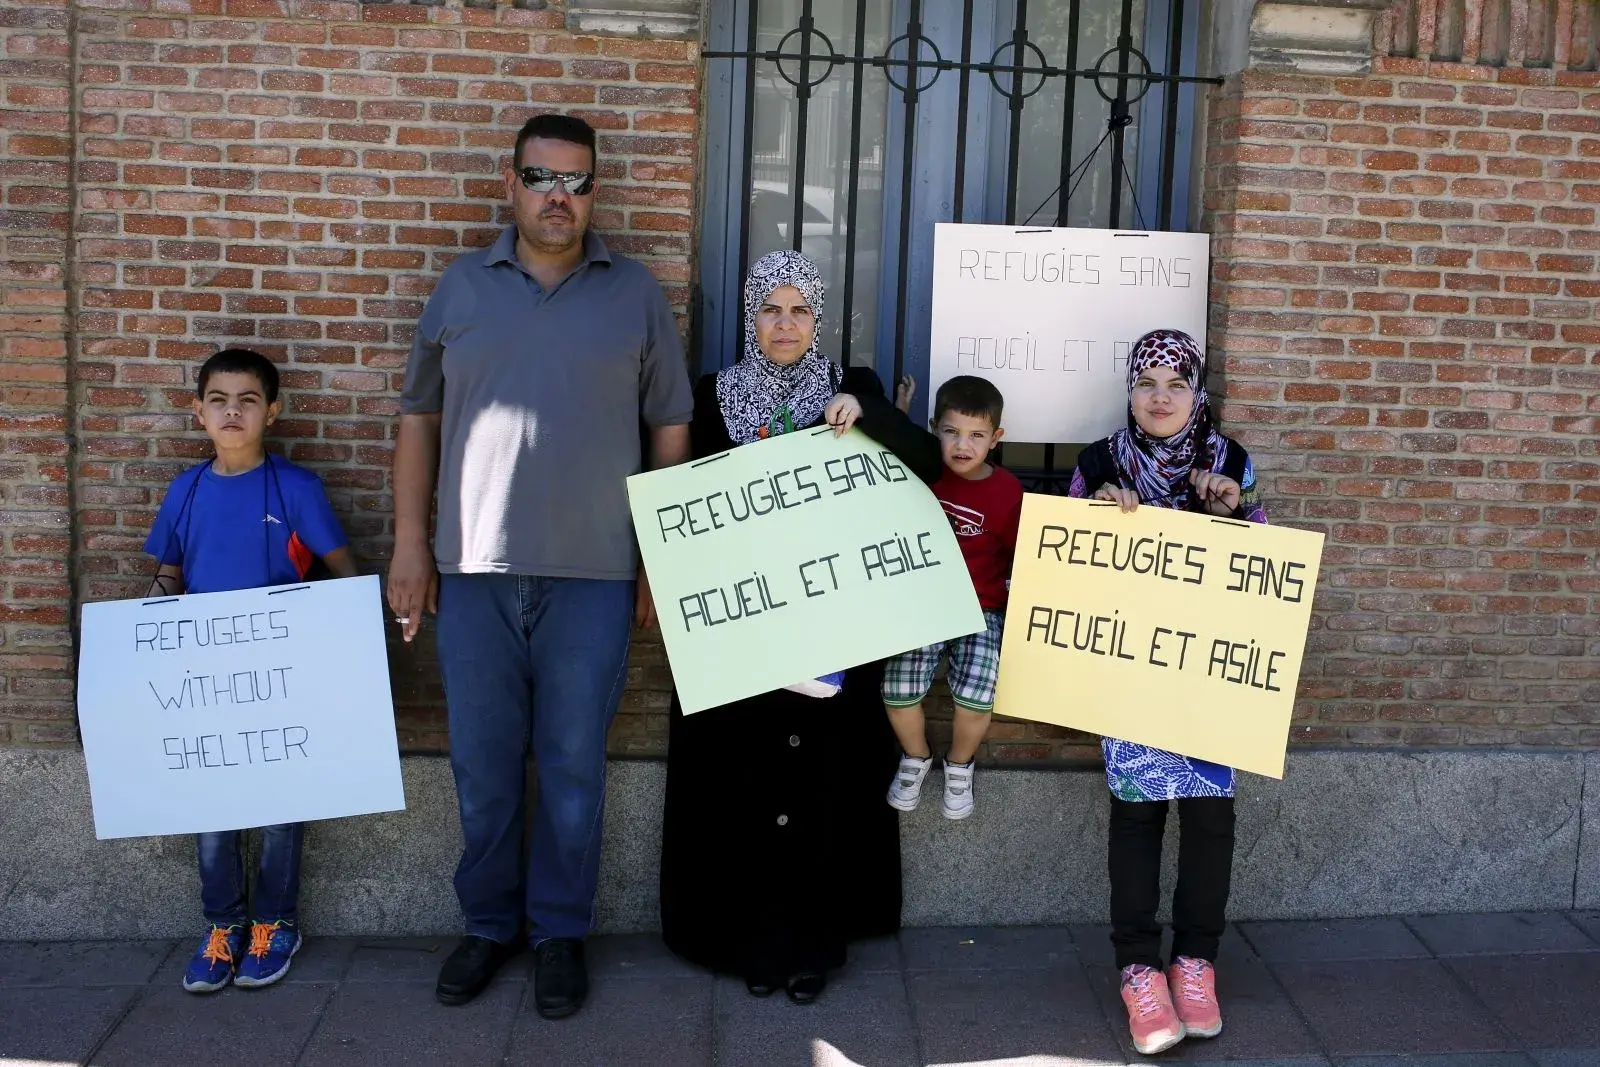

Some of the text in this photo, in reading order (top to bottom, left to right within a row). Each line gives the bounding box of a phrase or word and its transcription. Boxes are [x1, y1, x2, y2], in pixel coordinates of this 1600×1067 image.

[1119, 256, 1192, 288] SANS
[1062, 339, 1097, 372] ET
[825, 450, 908, 496] SANS
[799, 552, 841, 598] ET
[1226, 552, 1306, 603] SANS
[135, 609, 289, 652] REFUGEES
[1149, 627, 1196, 671] ET
[163, 725, 308, 770] SHELTER
